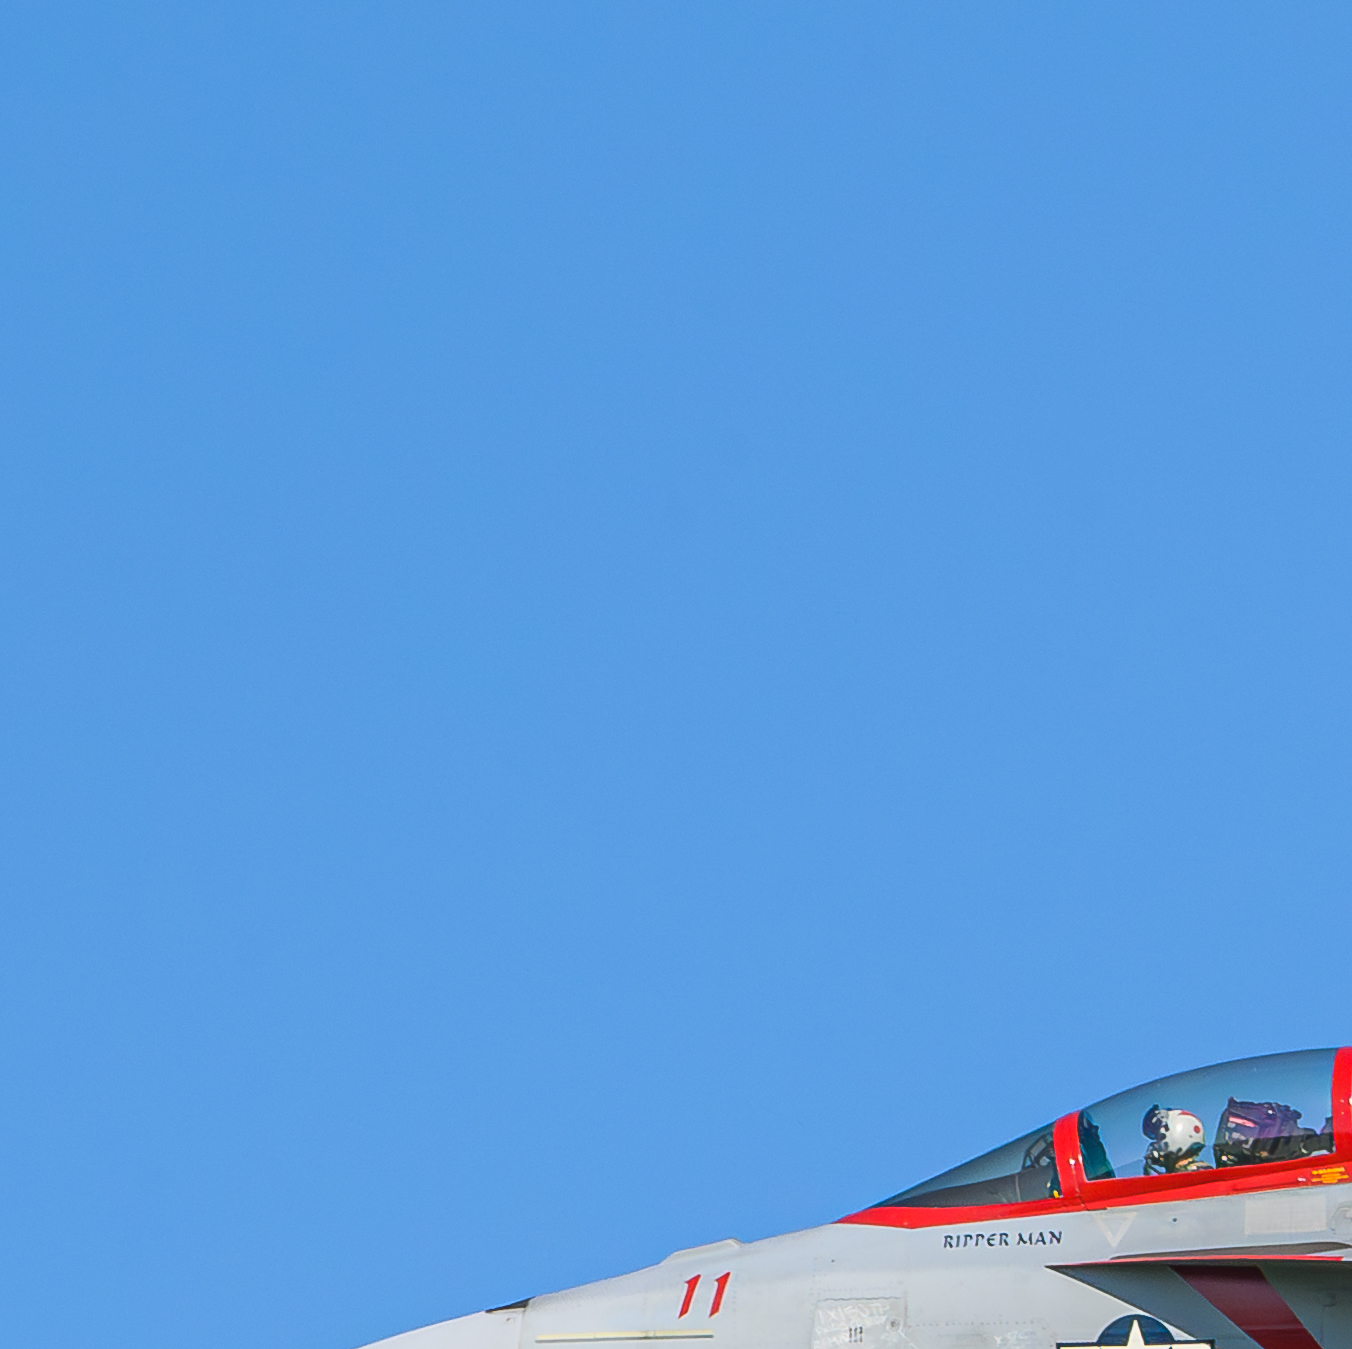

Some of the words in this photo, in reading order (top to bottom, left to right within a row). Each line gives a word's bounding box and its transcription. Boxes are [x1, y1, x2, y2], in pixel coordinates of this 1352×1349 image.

[943, 1232, 1009, 1249] RIPPER
[1016, 1230, 1063, 1246] MAN
[678, 1271, 731, 1319] 11
